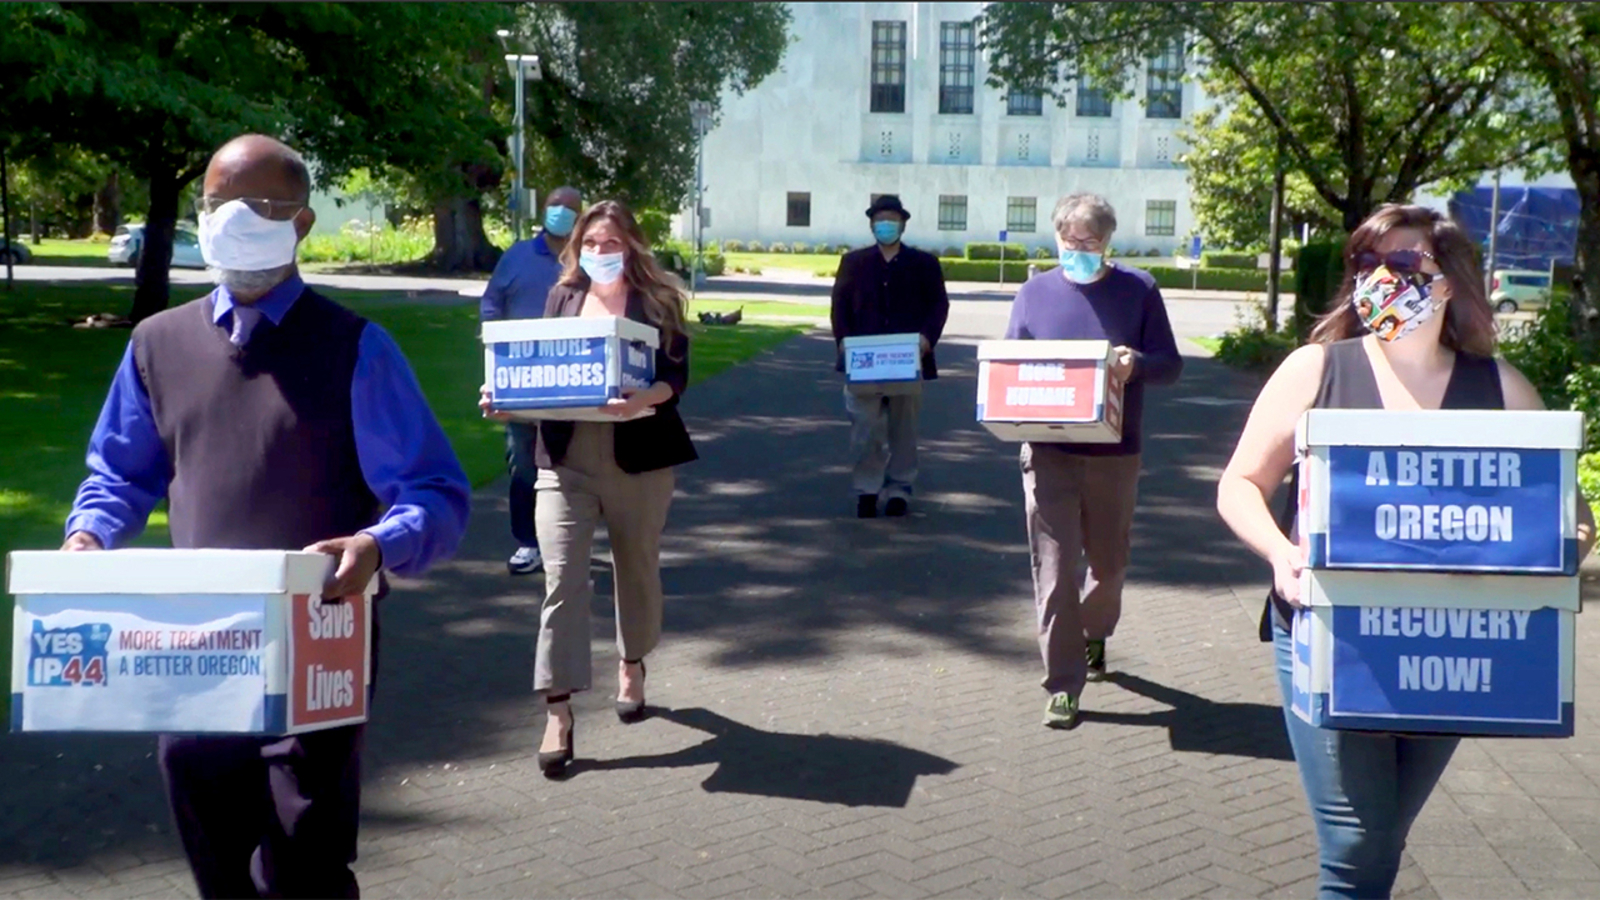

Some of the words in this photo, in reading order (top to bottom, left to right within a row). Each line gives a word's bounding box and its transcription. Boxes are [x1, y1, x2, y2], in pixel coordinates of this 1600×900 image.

[496, 362, 605, 389] OVERDOSES
[1018, 363, 1065, 381] MORE
[1006, 387, 1076, 406] HUMANE
[1365, 451, 1390, 486] A
[1397, 451, 1522, 488] BETTER
[1375, 504, 1513, 542] OREGON
[308, 593, 354, 640] Save
[1360, 606, 1531, 641] RECOVERY
[34, 632, 83, 654] YES
[119, 630, 163, 651] MORE
[169, 629, 262, 651] TREATMENT
[33, 655, 106, 684] IP44
[119, 655, 129, 676] A
[133, 655, 193, 676] BETTER
[197, 654, 261, 676] OREGON
[1399, 655, 1492, 692] NOW!
[306, 664, 354, 711] Lives
